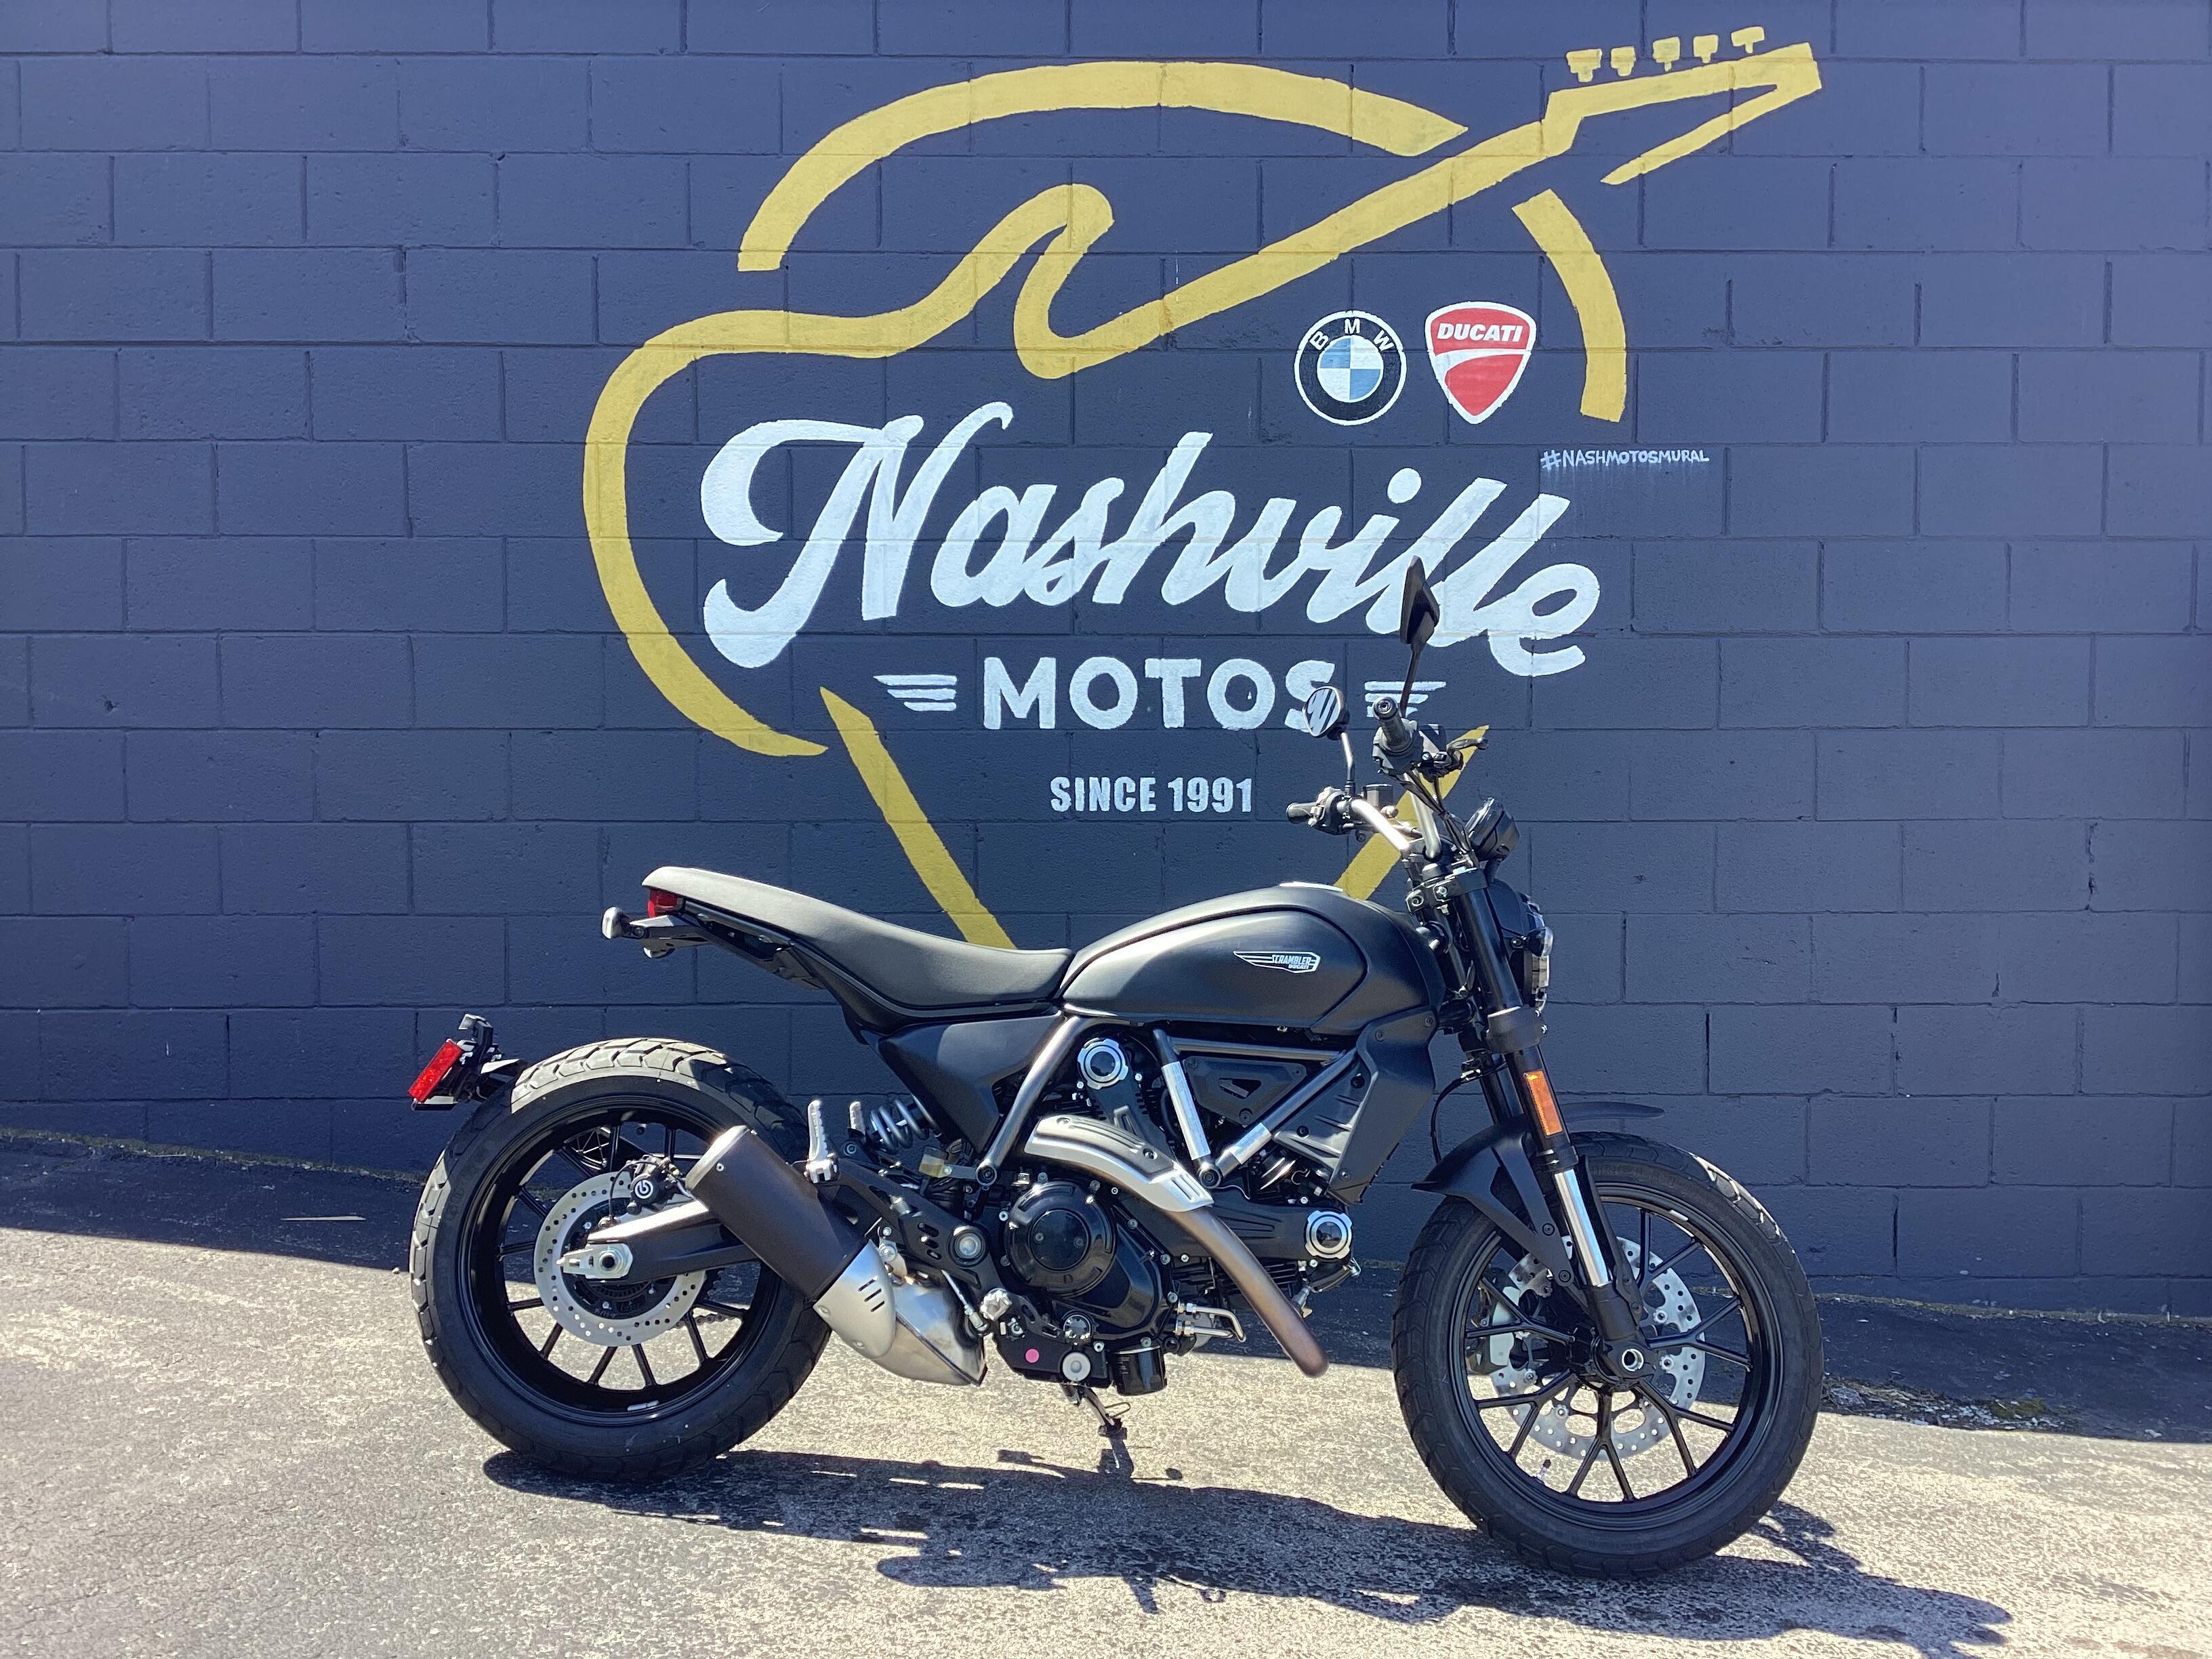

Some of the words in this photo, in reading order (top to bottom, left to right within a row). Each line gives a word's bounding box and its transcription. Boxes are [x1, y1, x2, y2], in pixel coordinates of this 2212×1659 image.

[1309, 318, 1395, 352] BMW
[1436, 323, 1524, 344] DUCATI
[1540, 449, 1710, 471] #NASHMOTOSMURAL
[700, 401, 1601, 678] Nashville
[983, 656, 1336, 733] MOTOS
[1050, 776, 1157, 813] SINCE
[1167, 777, 1252, 813] 1991
[1271, 954, 1312, 965] SCRAMBLER
